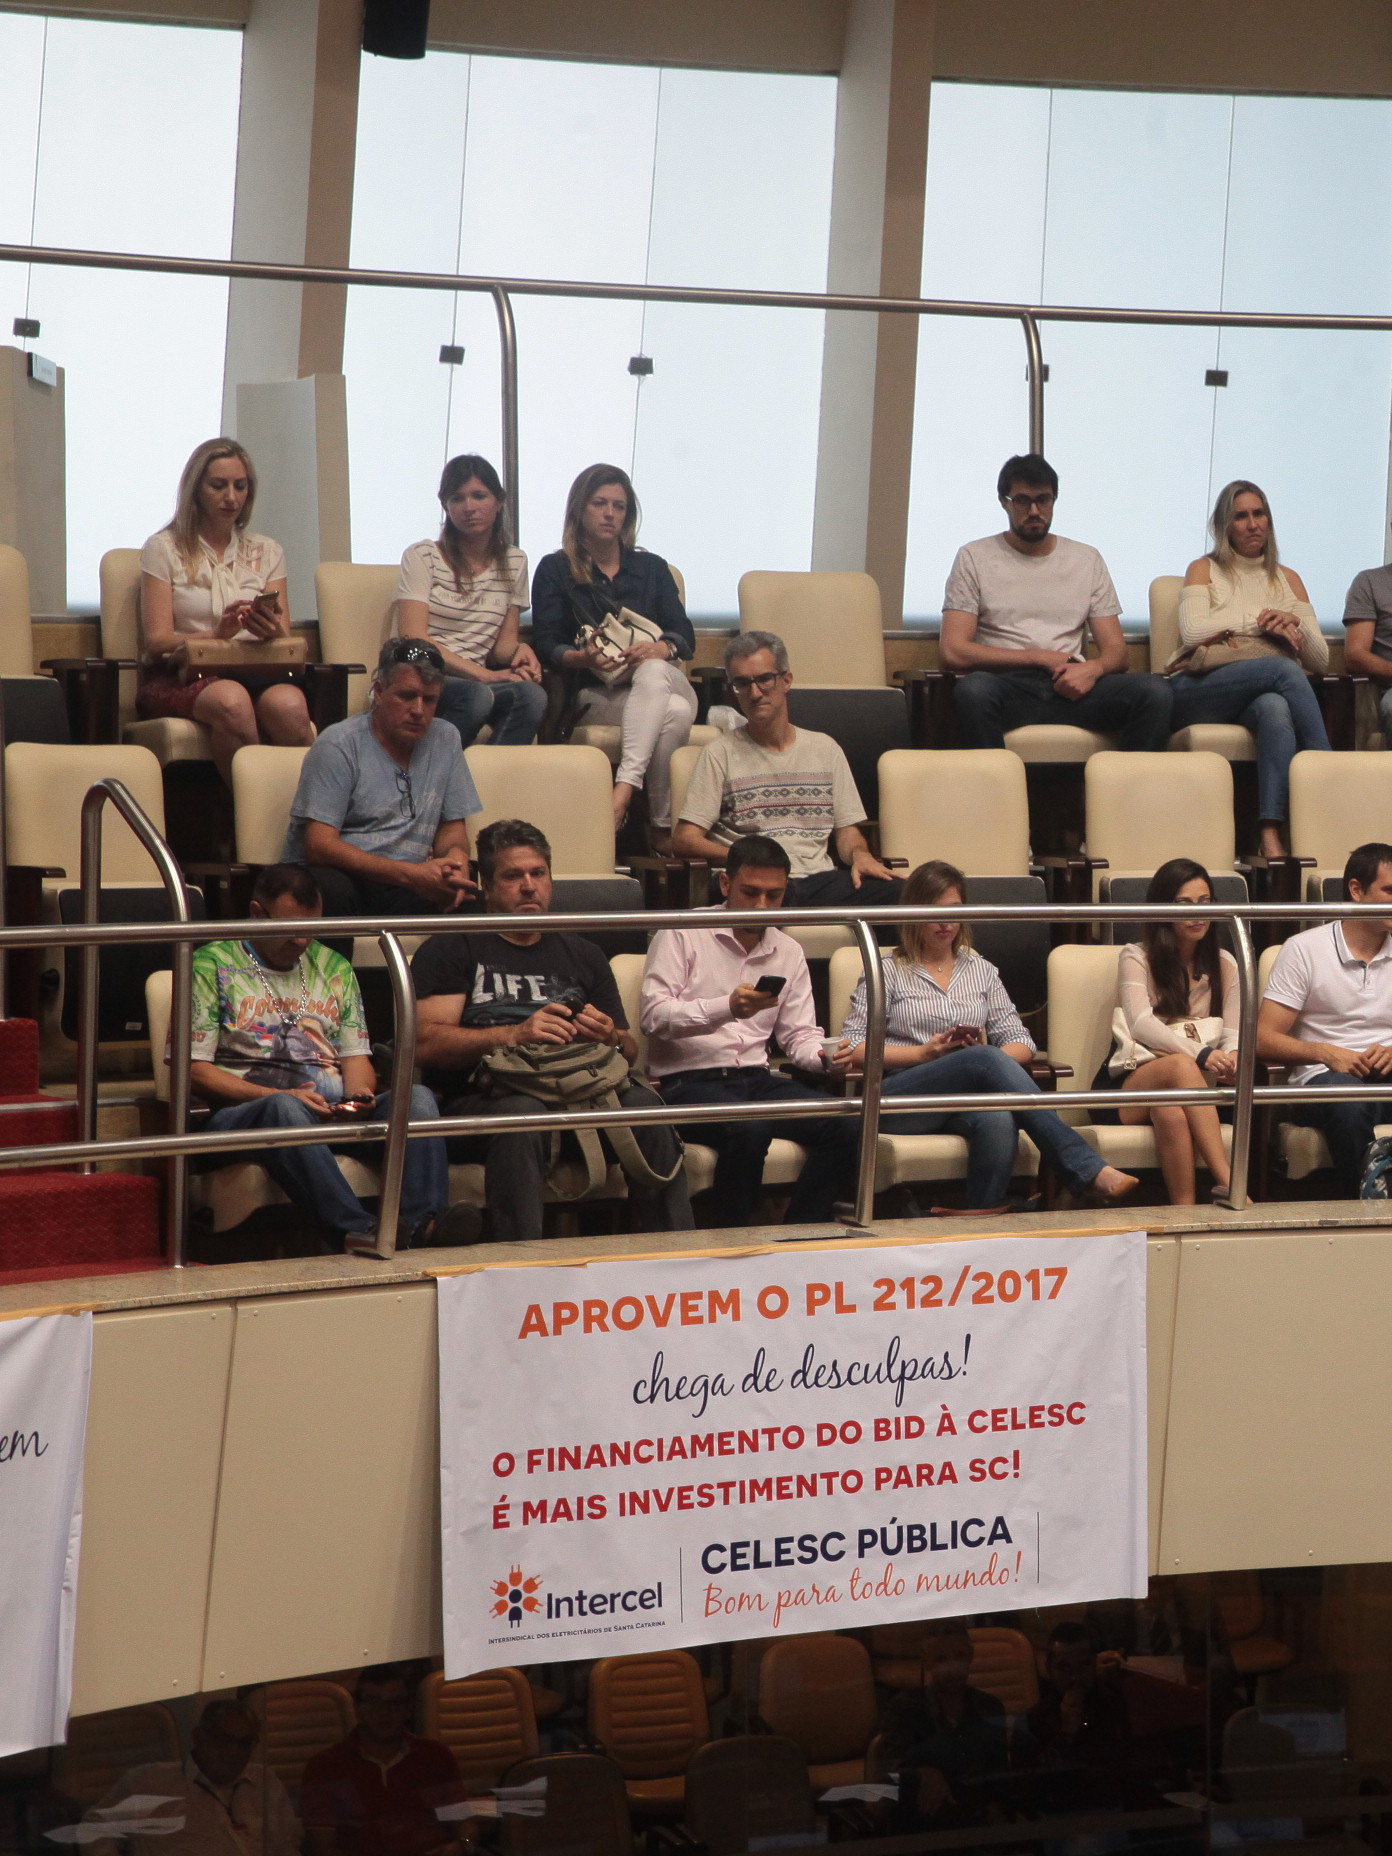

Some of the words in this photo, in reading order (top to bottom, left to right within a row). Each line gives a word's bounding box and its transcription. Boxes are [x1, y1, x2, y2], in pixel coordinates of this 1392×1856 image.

[471, 962, 548, 1004] LIFE
[517, 1288, 742, 1340] APROVEM
[755, 1284, 791, 1320] O
[805, 1281, 858, 1317] PL
[872, 1264, 1069, 1312] 212/2017
[632, 1350, 735, 1419] chega
[741, 1346, 785, 1394] de
[790, 1332, 972, 1409] desculpas!
[492, 1451, 516, 1478] O
[526, 1424, 806, 1475] FINANCIAMENTO
[815, 1419, 864, 1448] DO
[872, 1415, 927, 1443] BID
[935, 1403, 959, 1438] À
[966, 1401, 1088, 1434] CELESC
[491, 1493, 512, 1530] É
[522, 1494, 608, 1527] MAIS
[617, 1472, 865, 1518] INVESTIMENTO
[873, 1460, 960, 1492] PARA
[967, 1449, 1021, 1484] SC!
[700, 1530, 847, 1575] CELESC
[857, 1515, 1014, 1560] PÚBLICA
[546, 1581, 663, 1620] Intercel
[703, 1582, 770, 1619] Bom
[772, 1583, 844, 1629] para
[848, 1562, 907, 1603] todo
[915, 1550, 1023, 1594] mundo!
[488, 1634, 535, 1645] INTERSINDICAL
[551, 1627, 603, 1639] ELETRICITÁRIOS
[613, 1623, 635, 1632] SANTA
[635, 1620, 666, 1630] CATARINA
